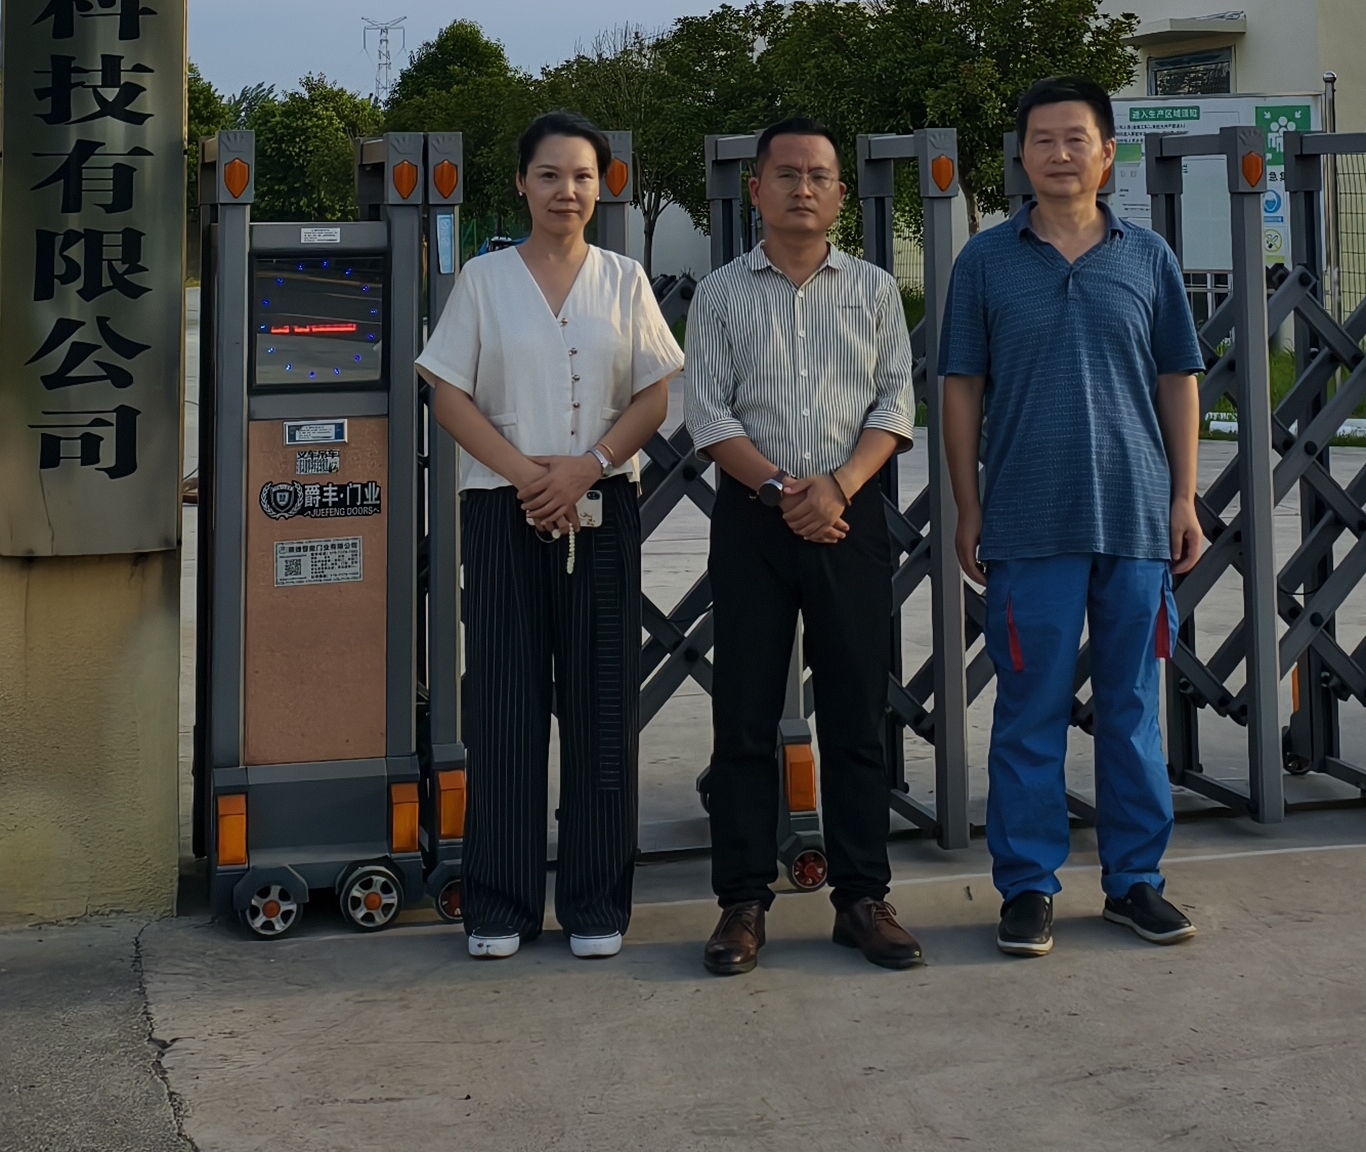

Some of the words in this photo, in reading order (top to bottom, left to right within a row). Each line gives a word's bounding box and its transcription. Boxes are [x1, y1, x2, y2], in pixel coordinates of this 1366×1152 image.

[304, 482, 381, 508] 爵丰·门业
[346, 507, 373, 516] DOORS
